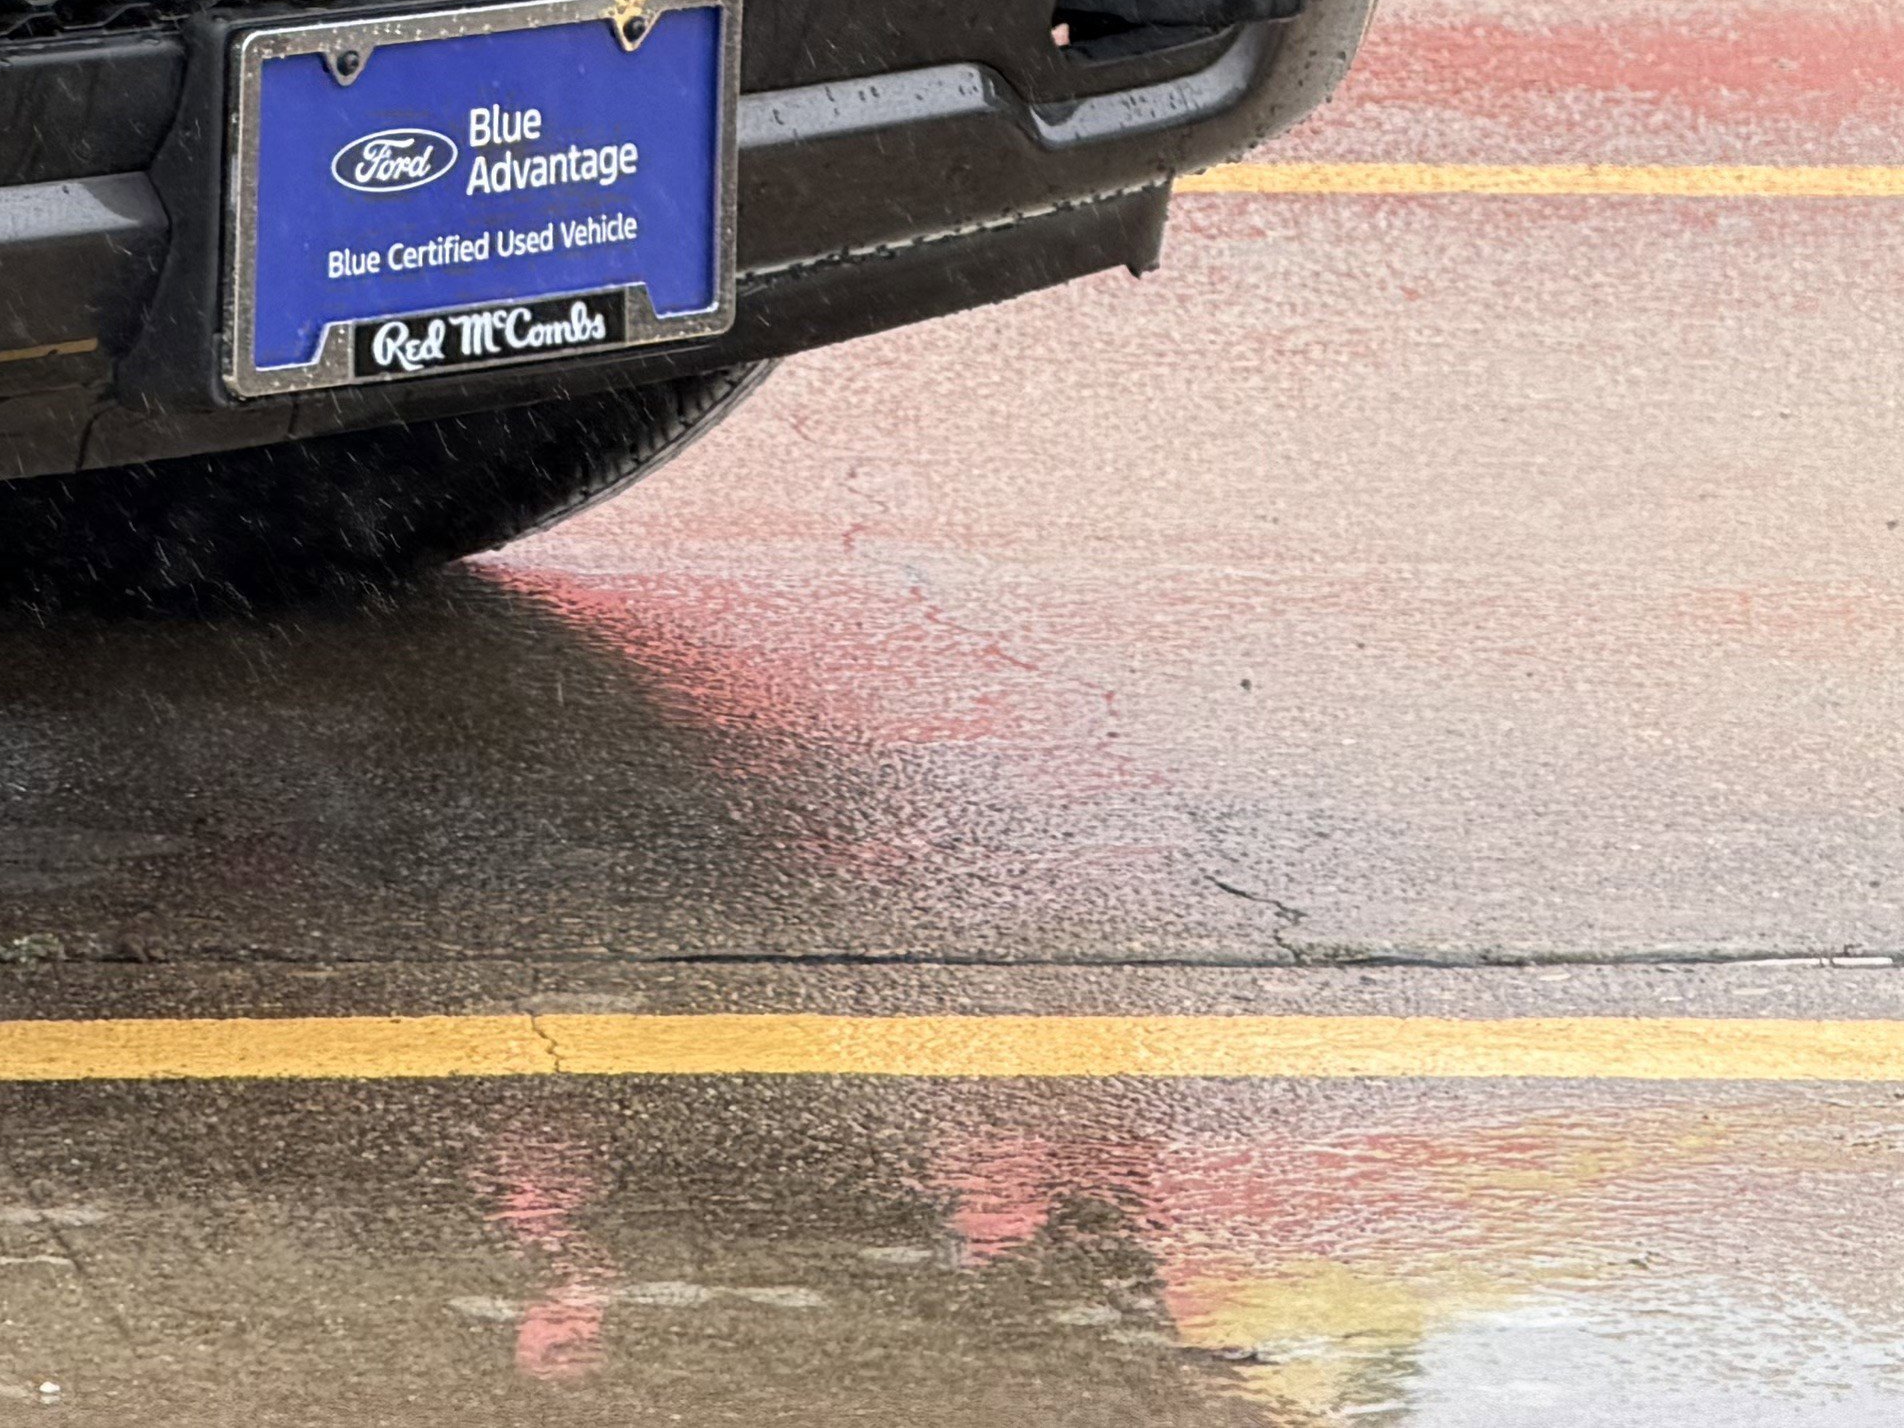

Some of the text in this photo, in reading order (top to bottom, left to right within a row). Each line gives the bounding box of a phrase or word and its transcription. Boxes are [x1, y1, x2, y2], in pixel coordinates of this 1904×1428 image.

[468, 104, 542, 147] Blue
[354, 137, 433, 183] Ford
[466, 142, 639, 197] Advantage
[327, 212, 638, 279] Blue Certified Used Vehicle
[371, 301, 606, 372] Red McCombs
